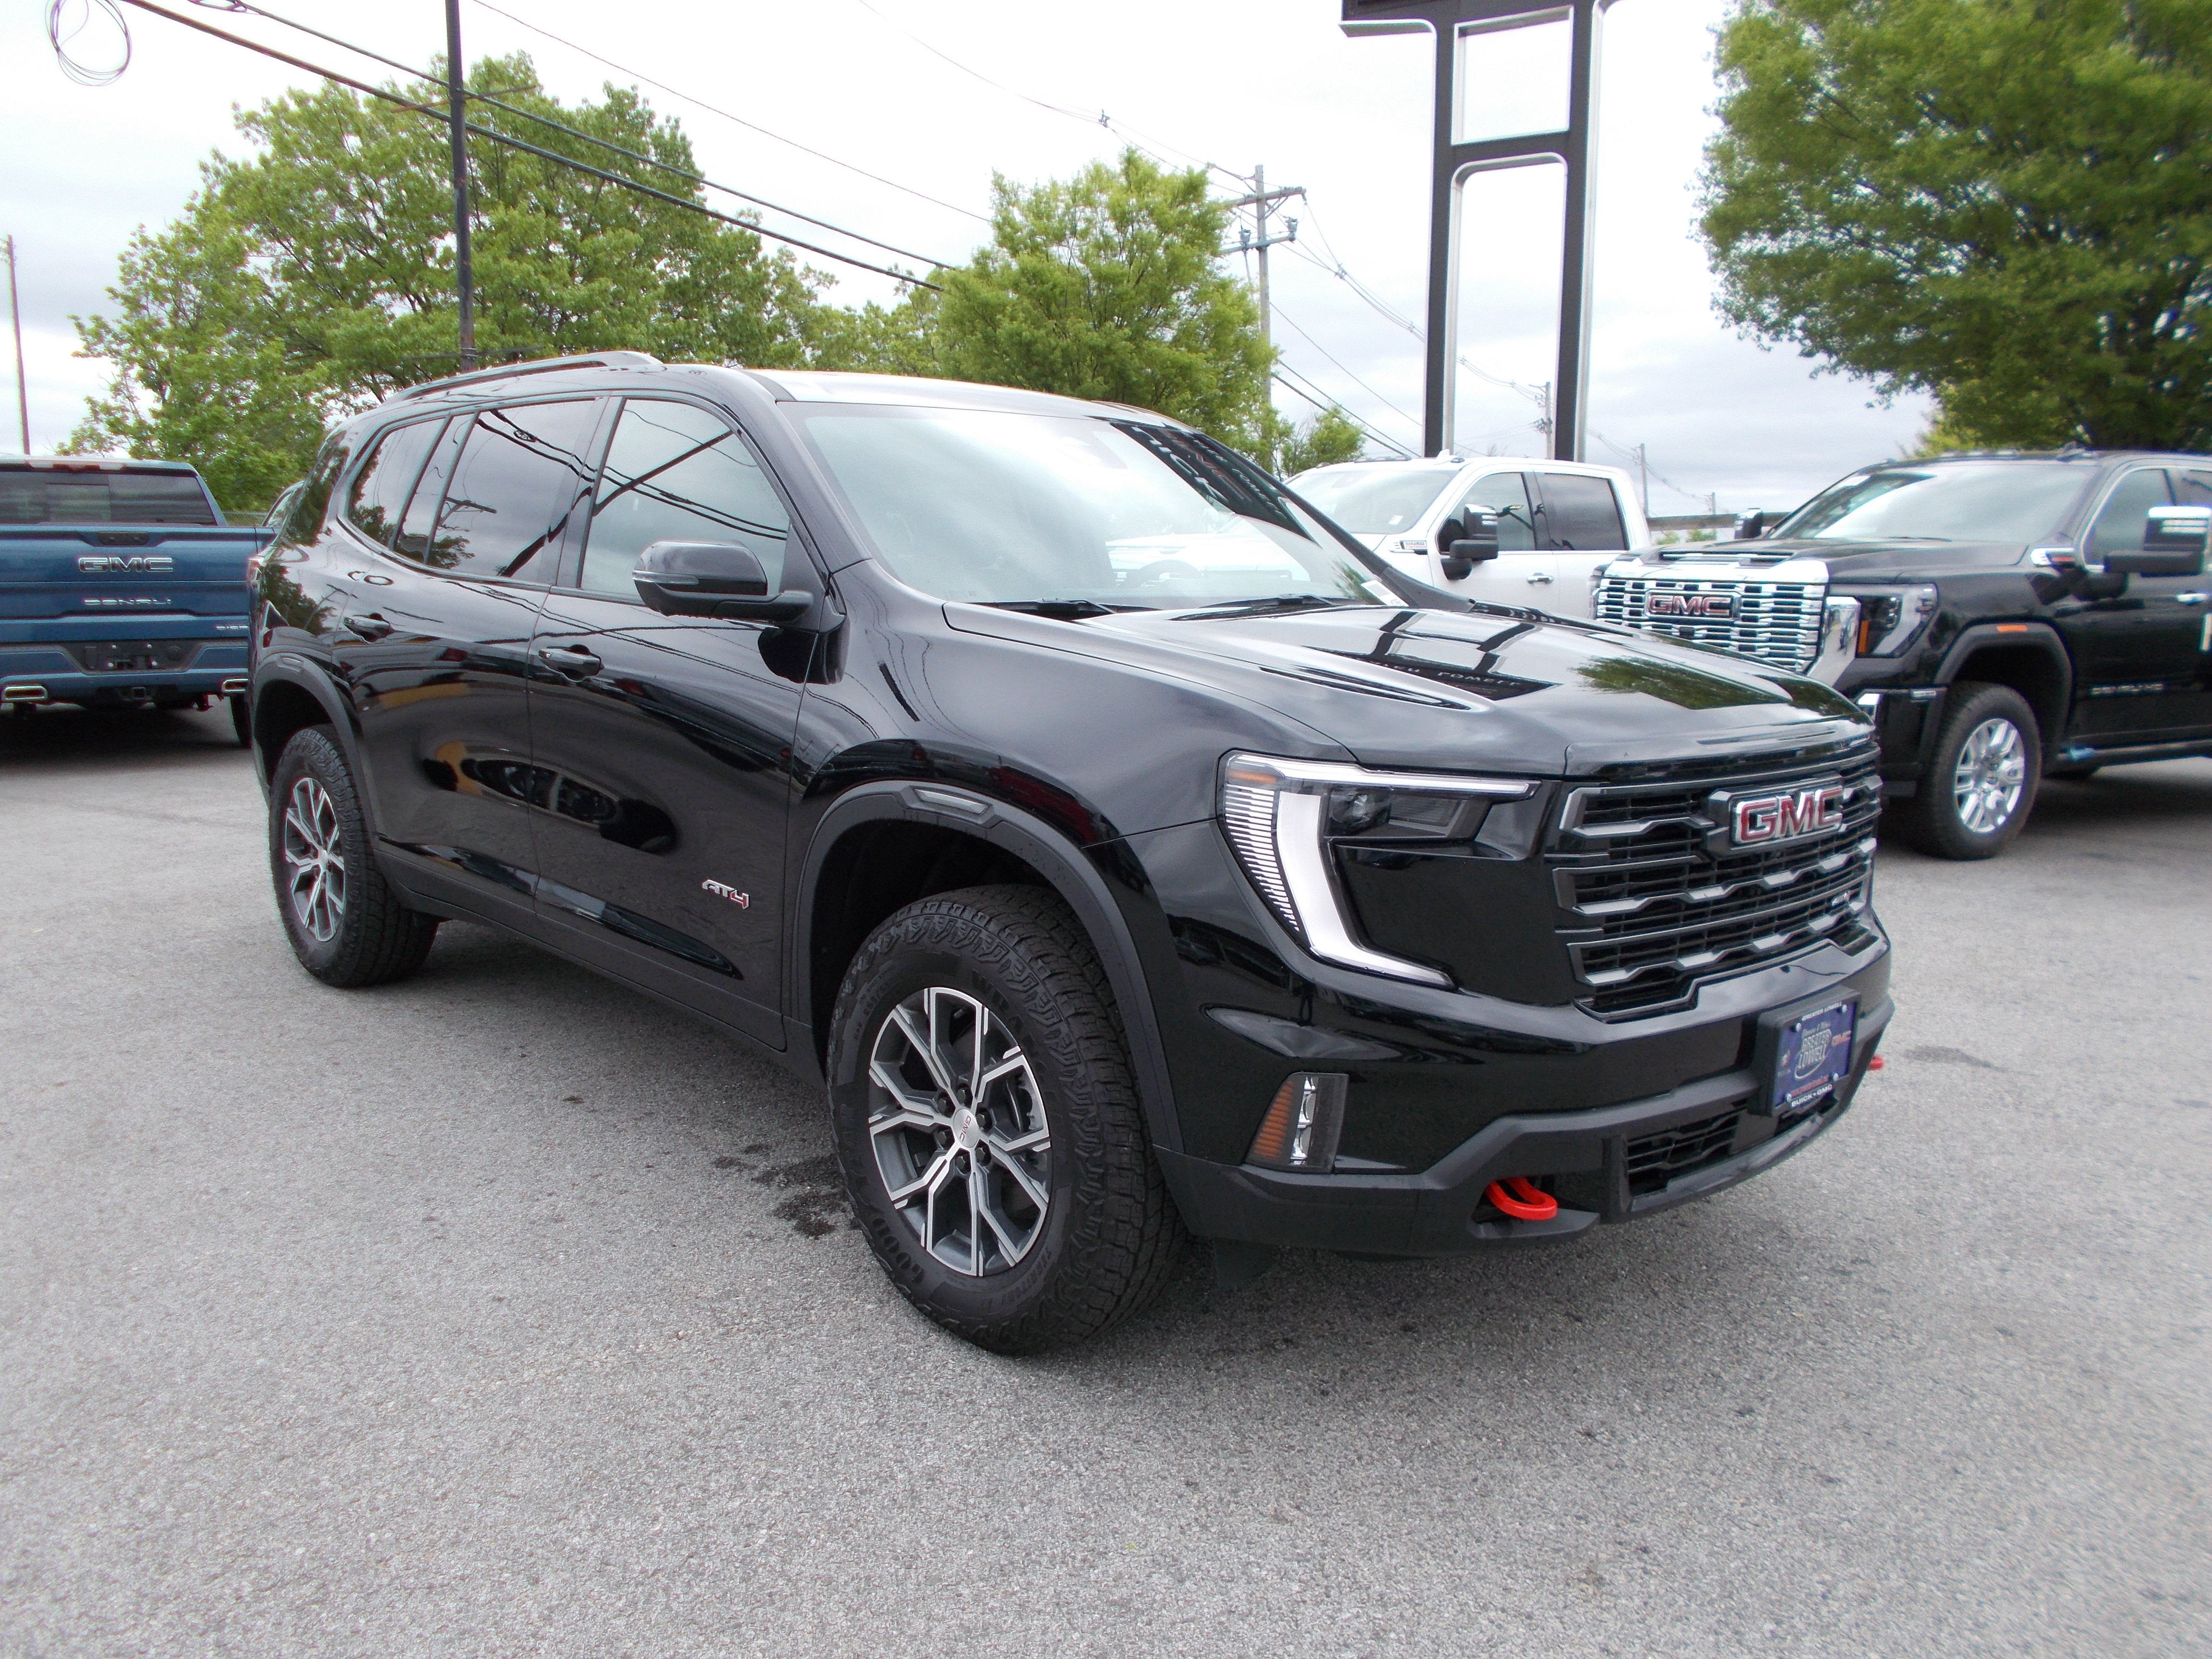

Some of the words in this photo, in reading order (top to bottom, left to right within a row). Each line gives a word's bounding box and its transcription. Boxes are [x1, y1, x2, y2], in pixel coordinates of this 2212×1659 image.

[78, 557, 173, 573] GMC
[1648, 595, 1731, 615] GMC
[1736, 786, 1843, 842] GMC
[702, 879, 749, 909] AT4
[1791, 1095, 1813, 1107] BUICK
[1817, 1084, 1833, 1095] GMC
[959, 1115, 972, 1142] GMC
